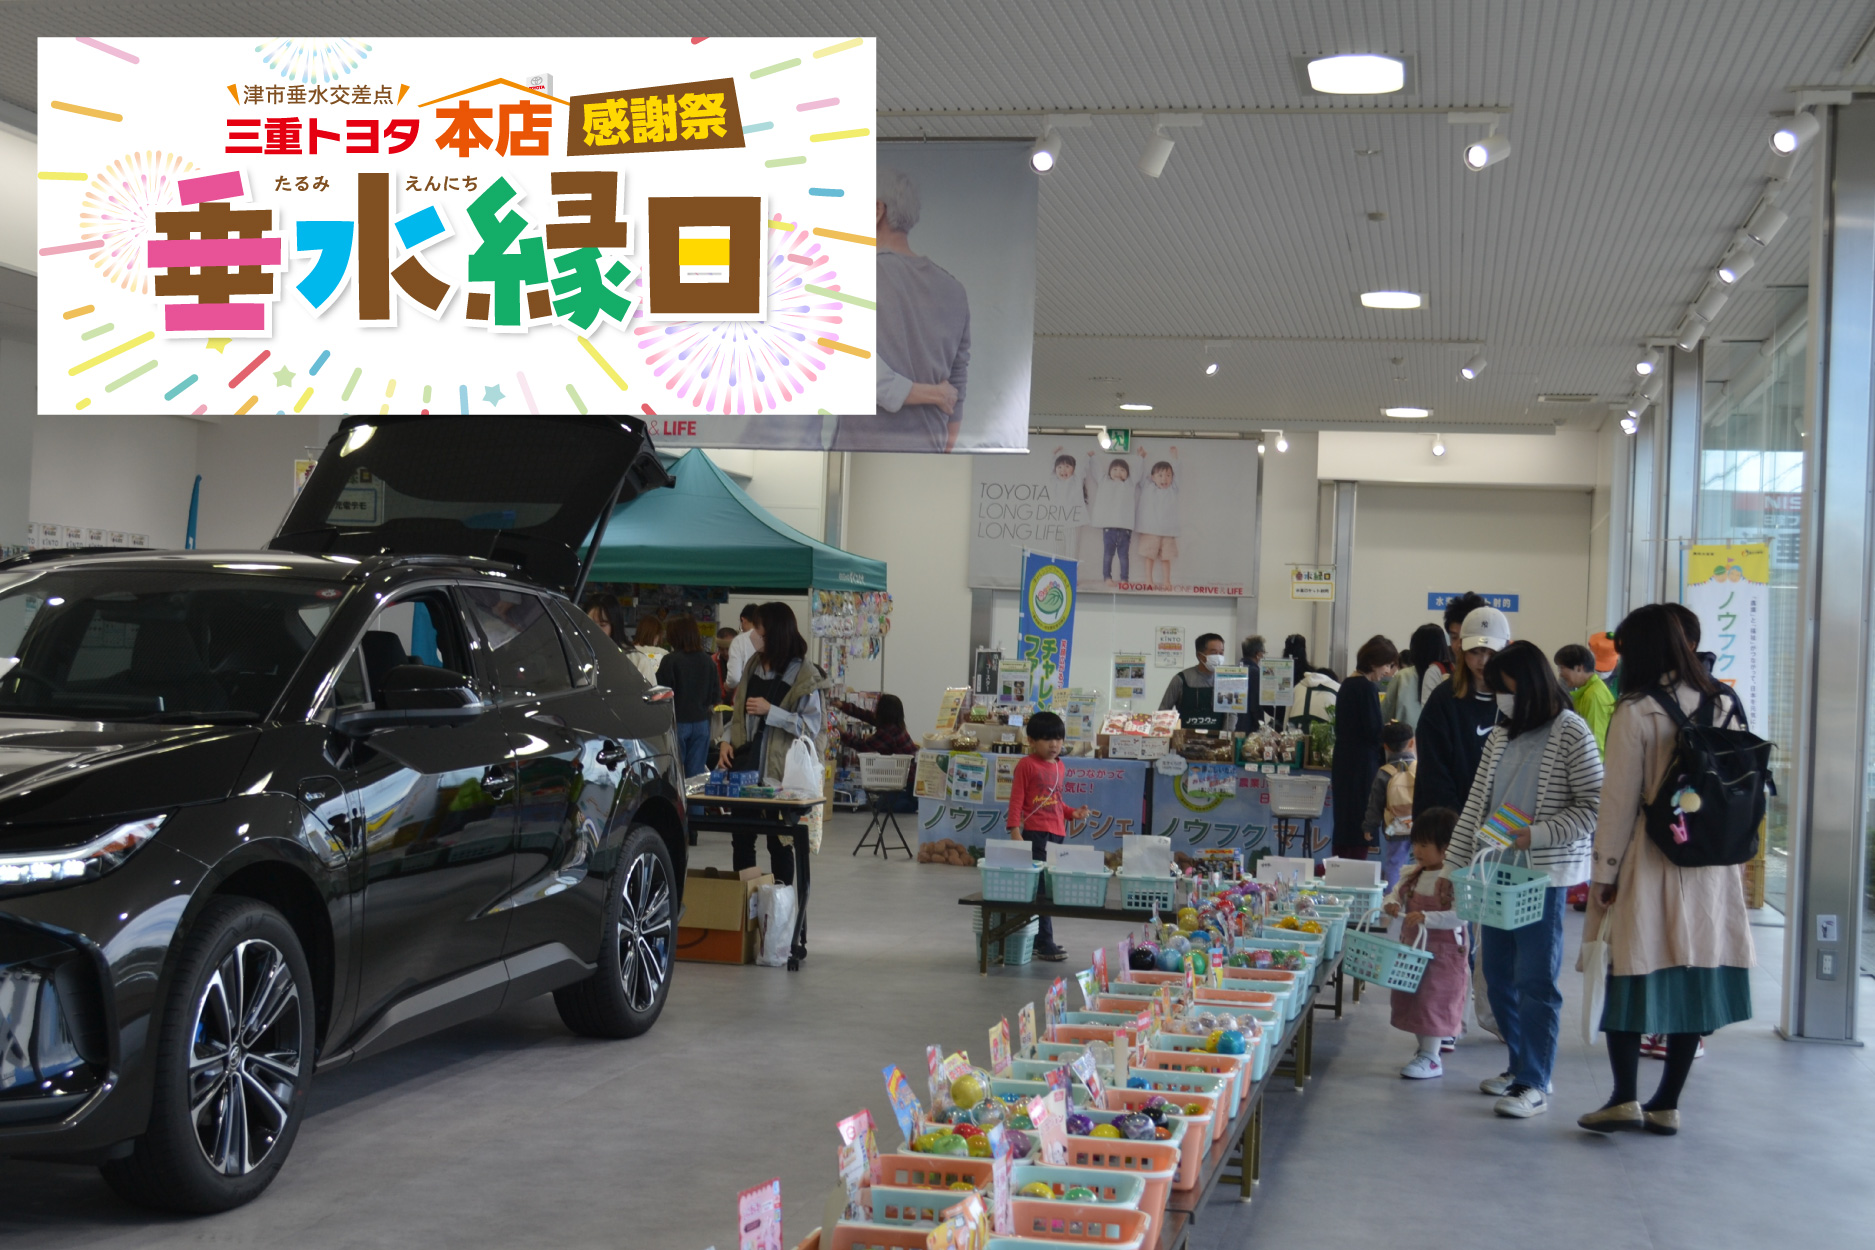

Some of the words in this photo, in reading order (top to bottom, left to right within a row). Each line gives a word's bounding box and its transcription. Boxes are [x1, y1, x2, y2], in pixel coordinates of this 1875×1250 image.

[663, 421, 697, 436] LIFE
[980, 482, 1050, 501] TOYOTA
[979, 503, 1033, 520] LONG
[1036, 504, 1082, 522] DRIVE
[978, 522, 1032, 539] LONG
[1035, 524, 1064, 541] LIFE
[1118, 582, 1153, 591] TOYOTA
[1193, 586, 1219, 595] DRIVE
[1227, 587, 1243, 595] LIFE
[1066, 768, 1125, 779] がつながって
